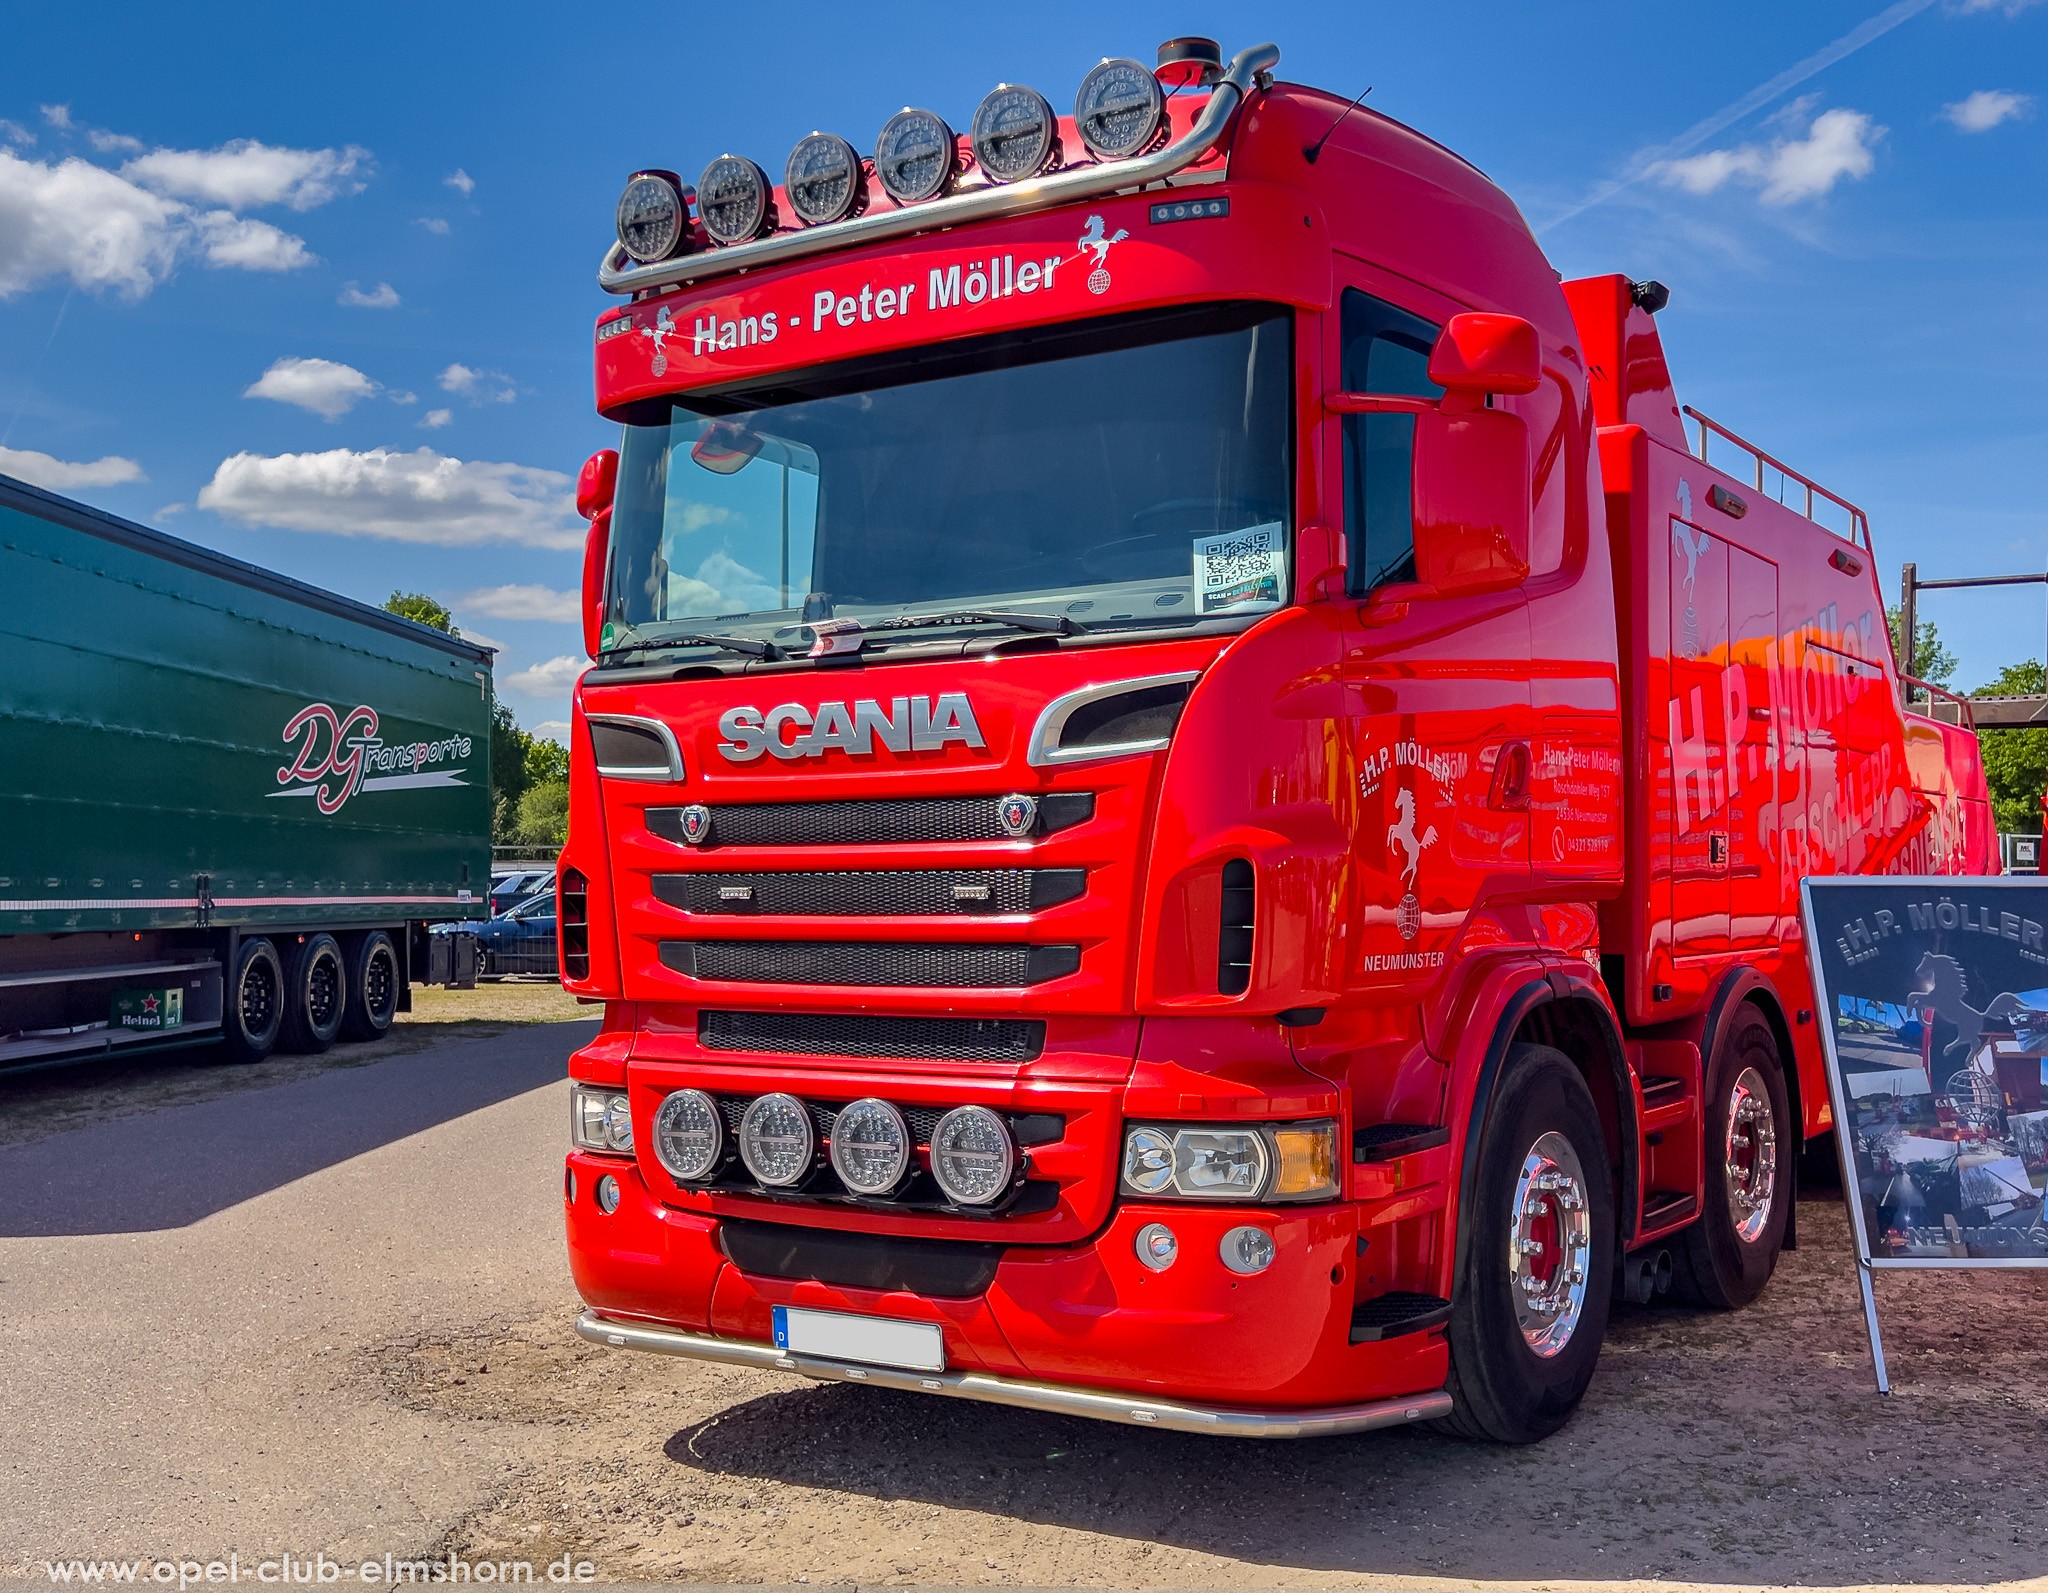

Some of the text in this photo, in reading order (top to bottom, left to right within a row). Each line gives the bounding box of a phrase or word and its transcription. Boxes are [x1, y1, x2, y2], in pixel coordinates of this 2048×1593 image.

[693, 310, 778, 357] Hans
[812, 282, 916, 333] Peter
[927, 255, 1062, 311] Möller
[717, 692, 987, 761] SCANIA
[1668, 601, 1872, 838] H.P. Möller
[347, 733, 471, 796] Transporte
[1363, 746, 1391, 783] H.P.
[1395, 737, 1450, 788] MÖLLER
[1591, 750, 1620, 776] Möller
[1843, 896, 2044, 952] H.P. MÖLLER
[1364, 950, 1444, 972] NEUMÜNSTER
[778, 1331, 785, 1342] D
